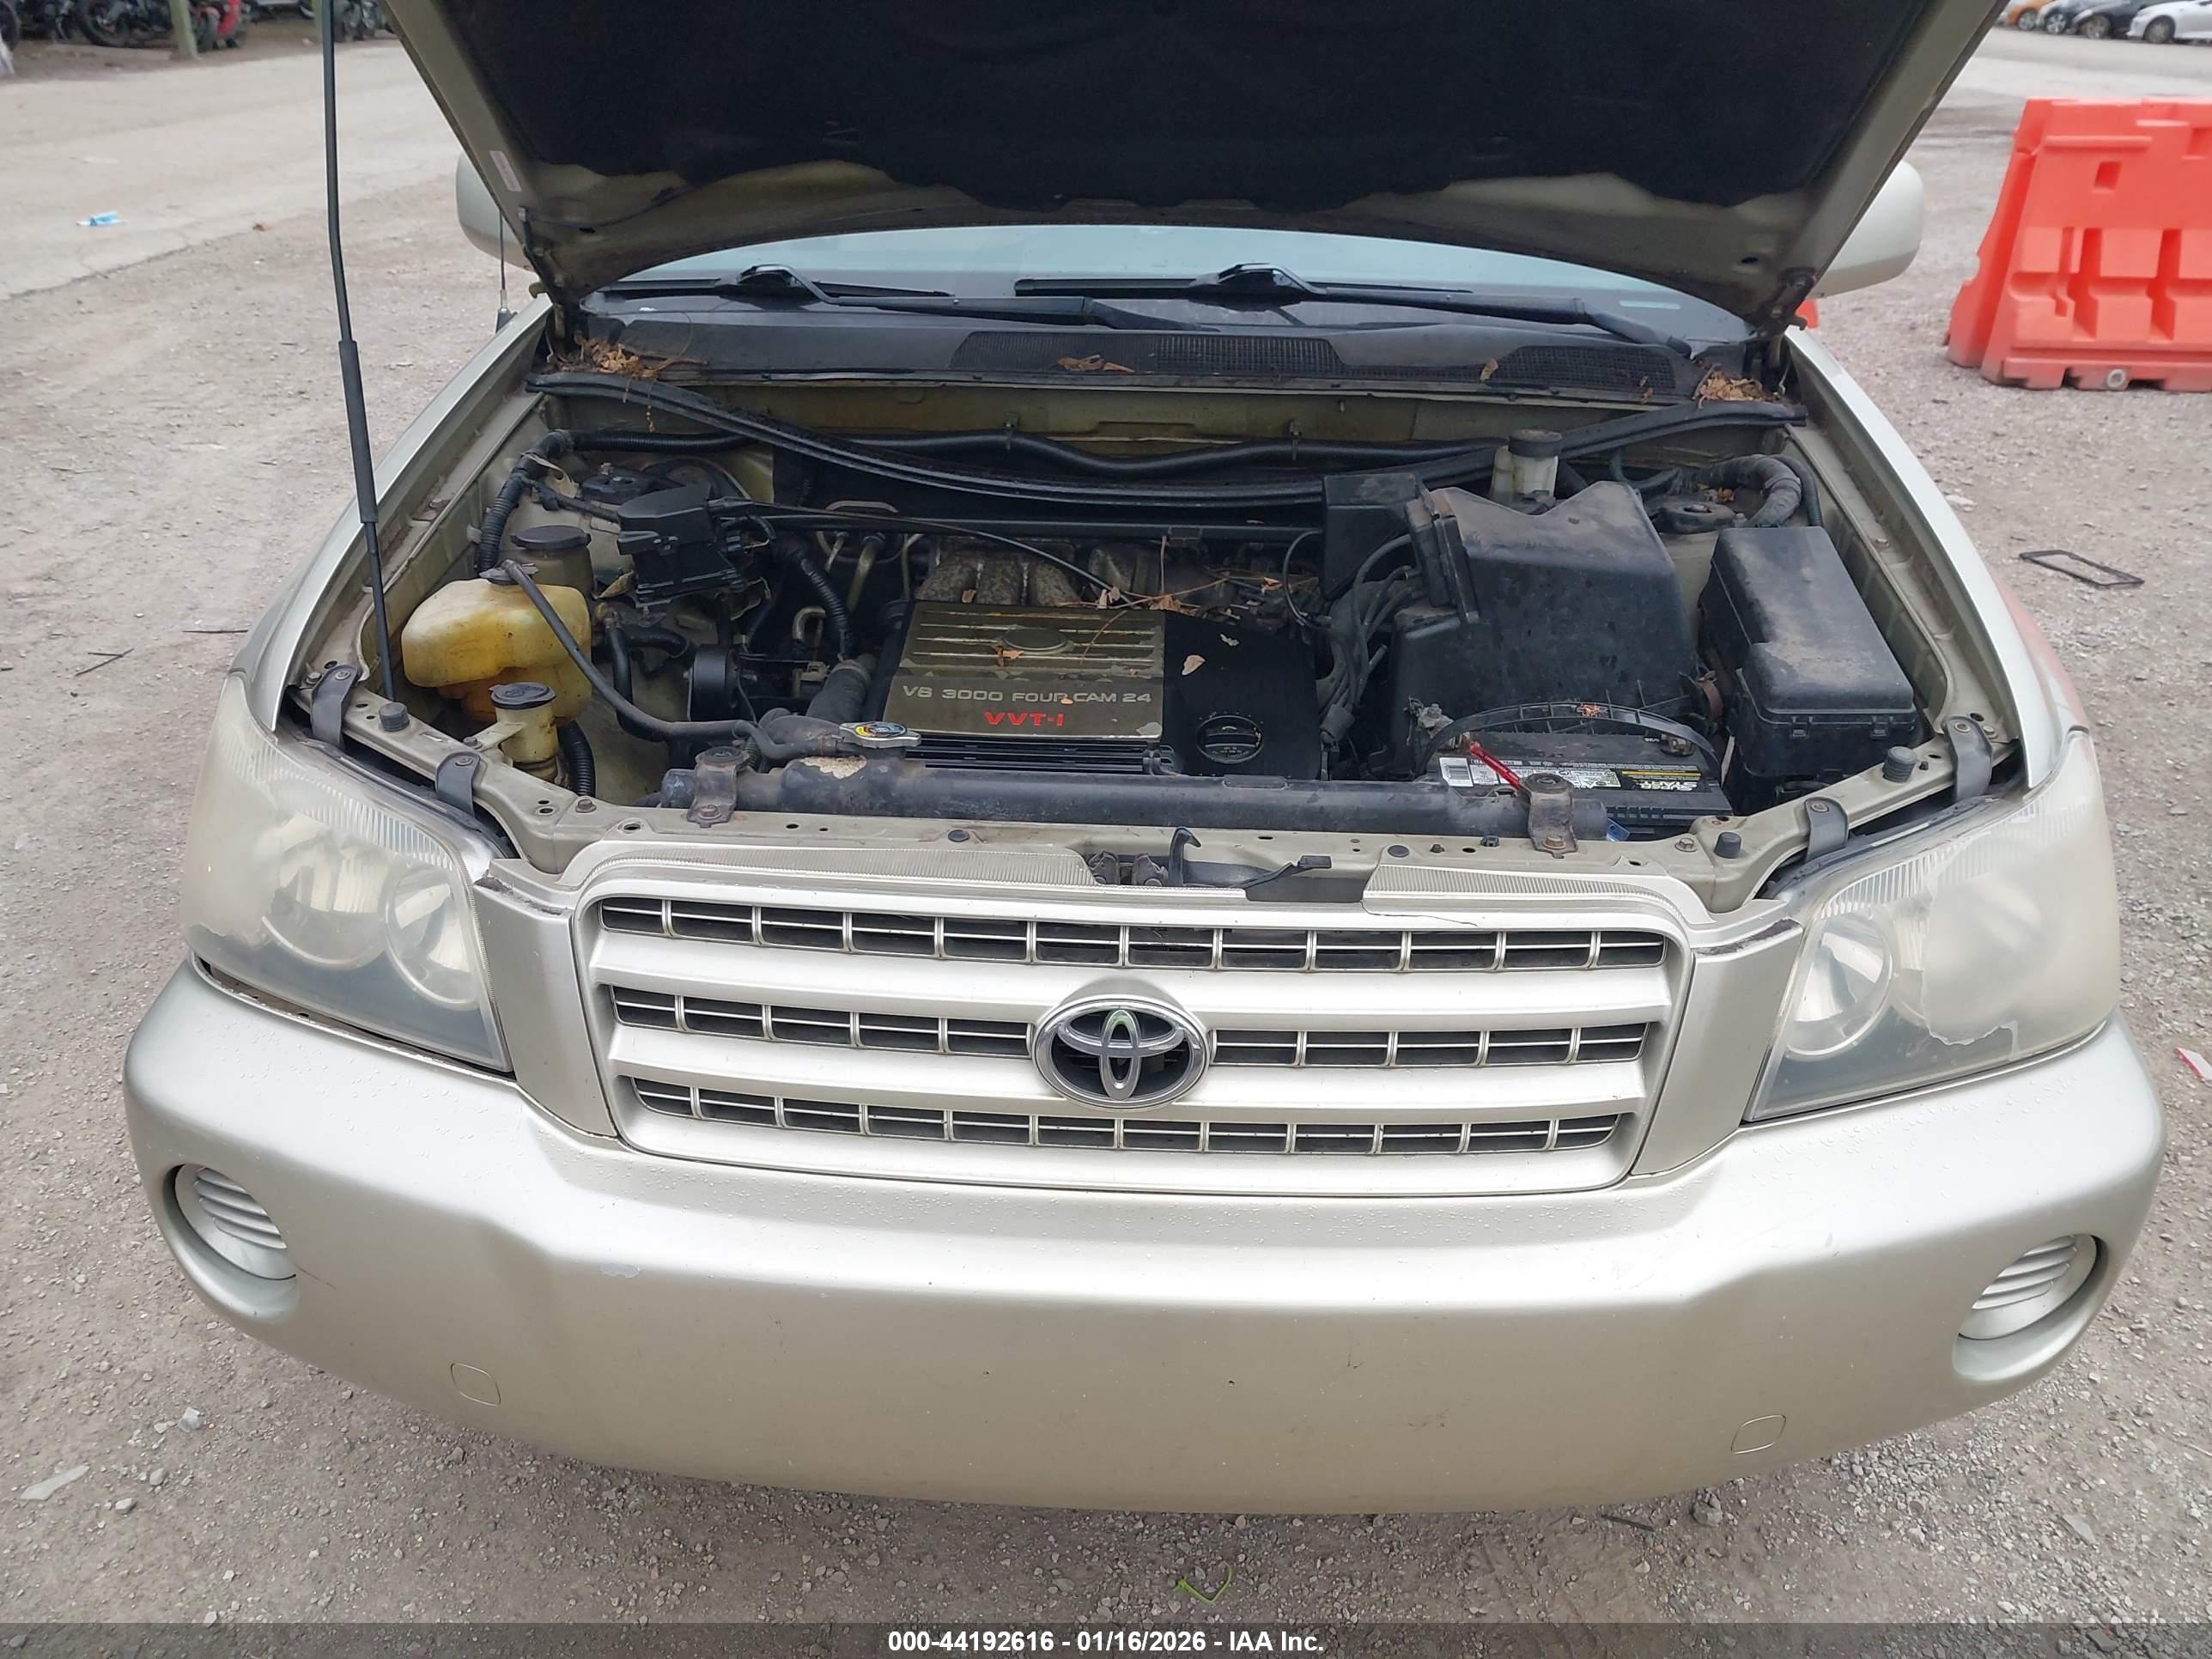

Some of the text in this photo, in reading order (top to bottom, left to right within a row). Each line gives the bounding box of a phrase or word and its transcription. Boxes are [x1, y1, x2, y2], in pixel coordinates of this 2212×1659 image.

[902, 685, 1152, 703] V6 3000 FOUR CAM 24
